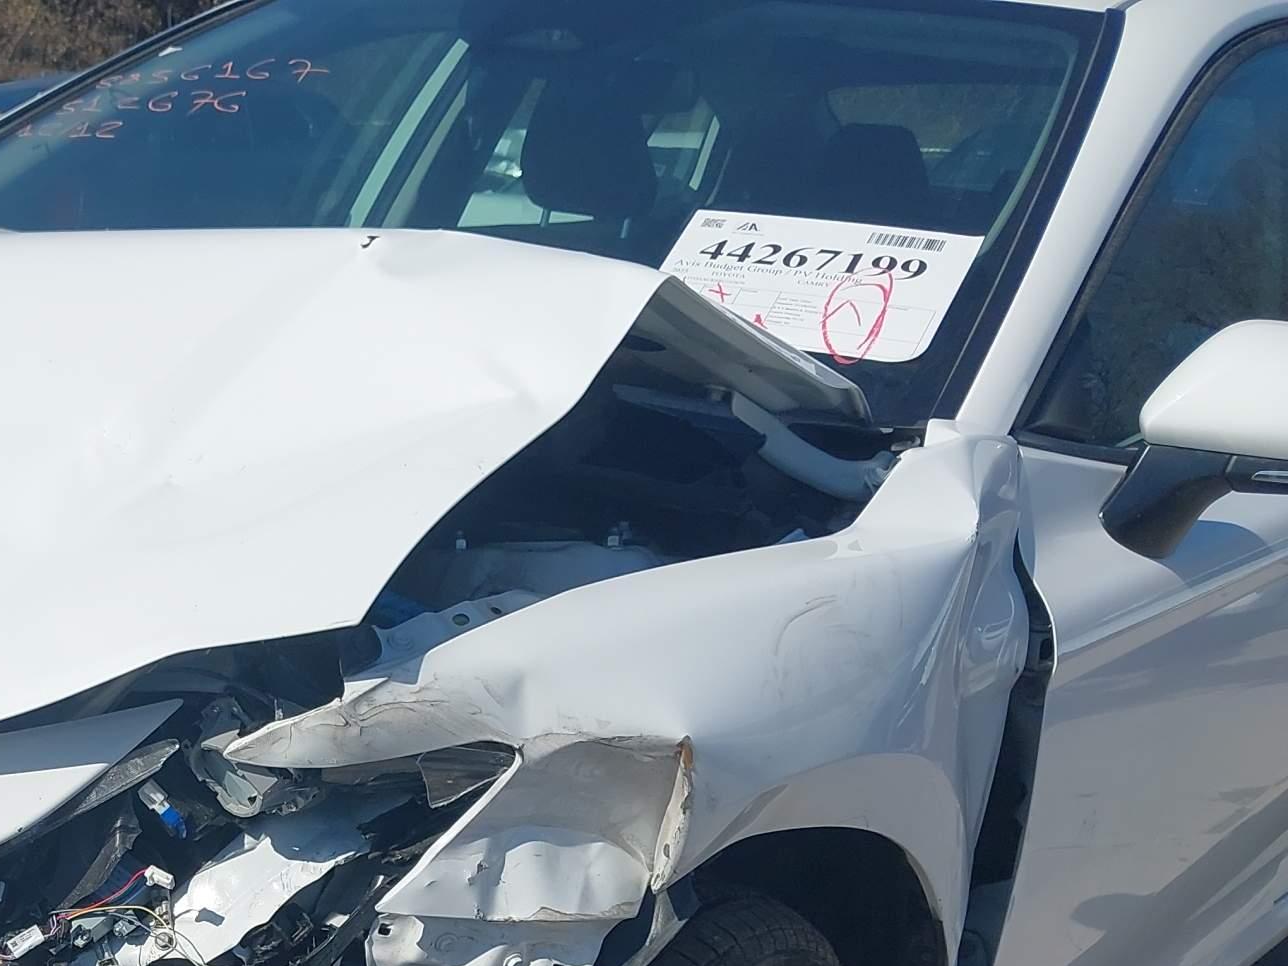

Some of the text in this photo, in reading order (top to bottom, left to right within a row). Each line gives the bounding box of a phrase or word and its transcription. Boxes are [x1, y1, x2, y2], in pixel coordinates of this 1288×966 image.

[674, 259, 701, 268] Avis
[704, 261, 744, 273] Budget
[746, 264, 783, 277] Group
[794, 270, 813, 279] PV
[699, 239, 928, 281] 44267199
